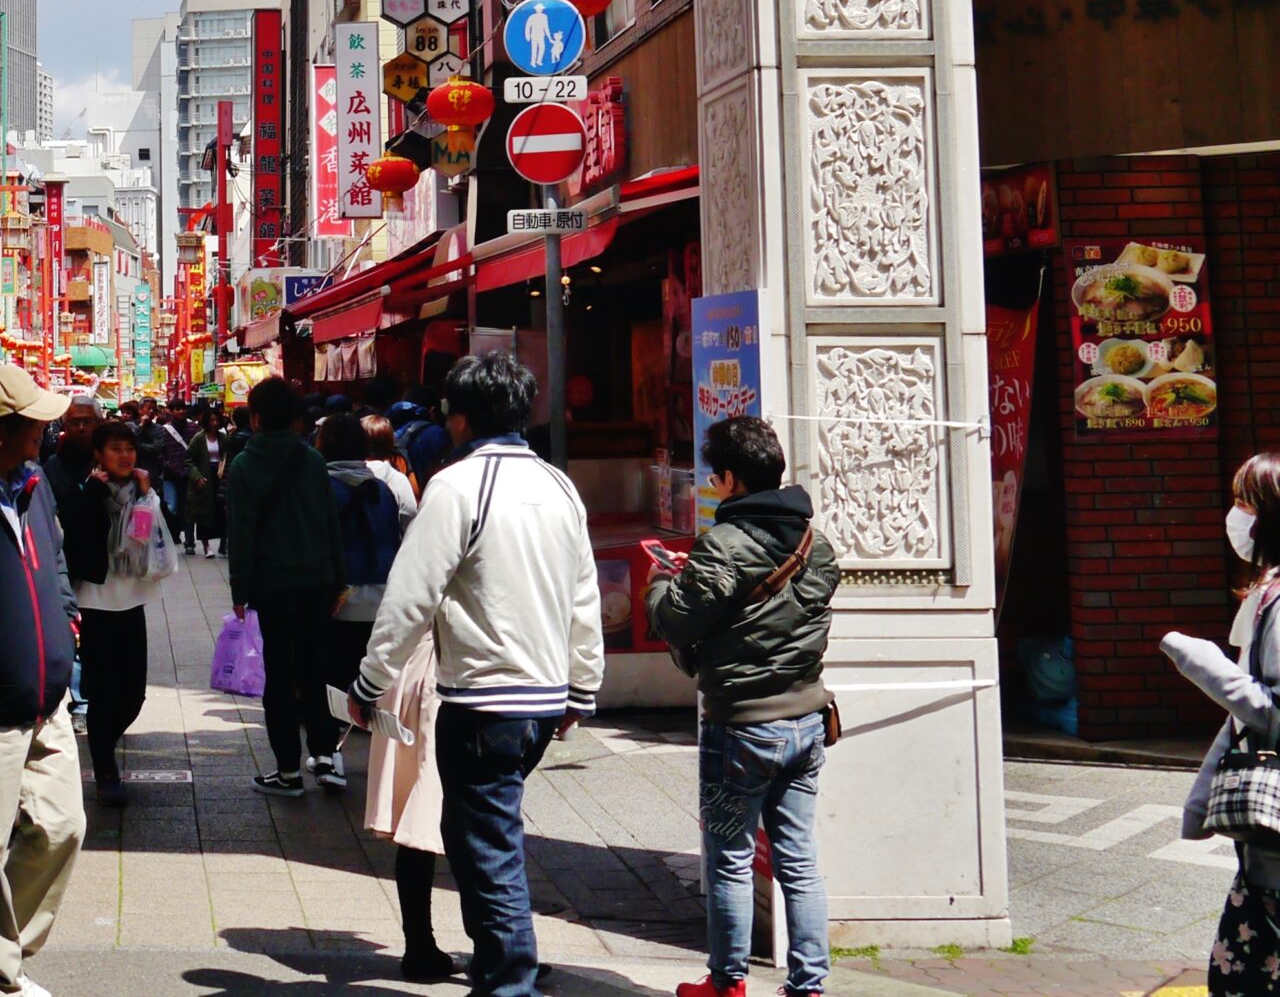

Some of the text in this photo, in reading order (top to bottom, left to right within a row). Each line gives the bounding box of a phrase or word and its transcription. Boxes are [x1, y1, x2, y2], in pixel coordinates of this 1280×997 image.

[348, 33, 366, 79] 飲茶
[415, 36, 438, 52] 88
[347, 91, 372, 206] 広州菜館
[512, 213, 584, 230] 自動車・原付
